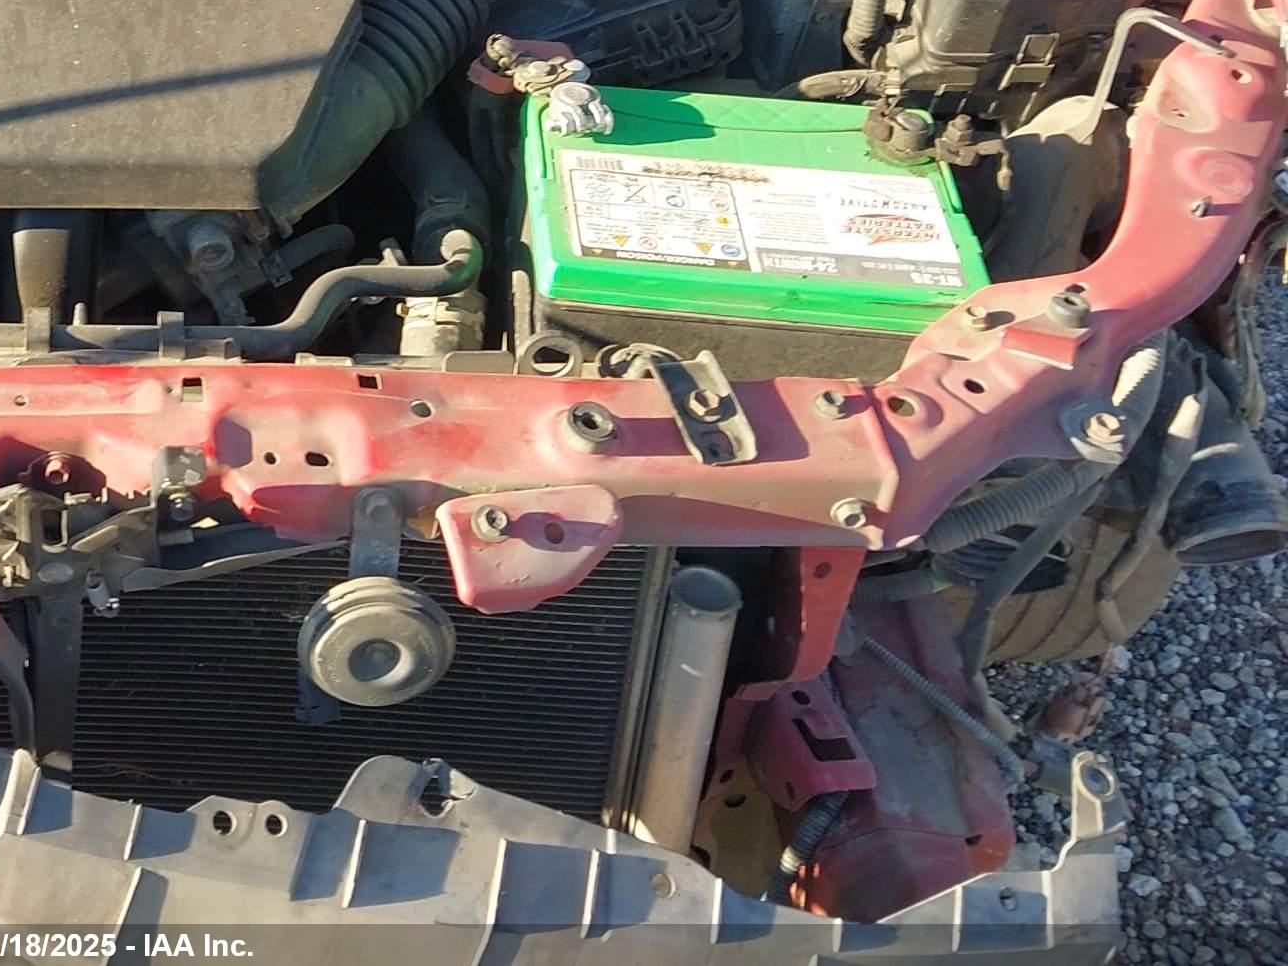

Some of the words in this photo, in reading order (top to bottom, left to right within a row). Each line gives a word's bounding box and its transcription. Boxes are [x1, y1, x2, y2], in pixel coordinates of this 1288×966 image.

[839, 197, 929, 212] AUTOMOTIVE
[848, 216, 935, 232] BATTERIES
[840, 224, 942, 243] INTERSTATE
